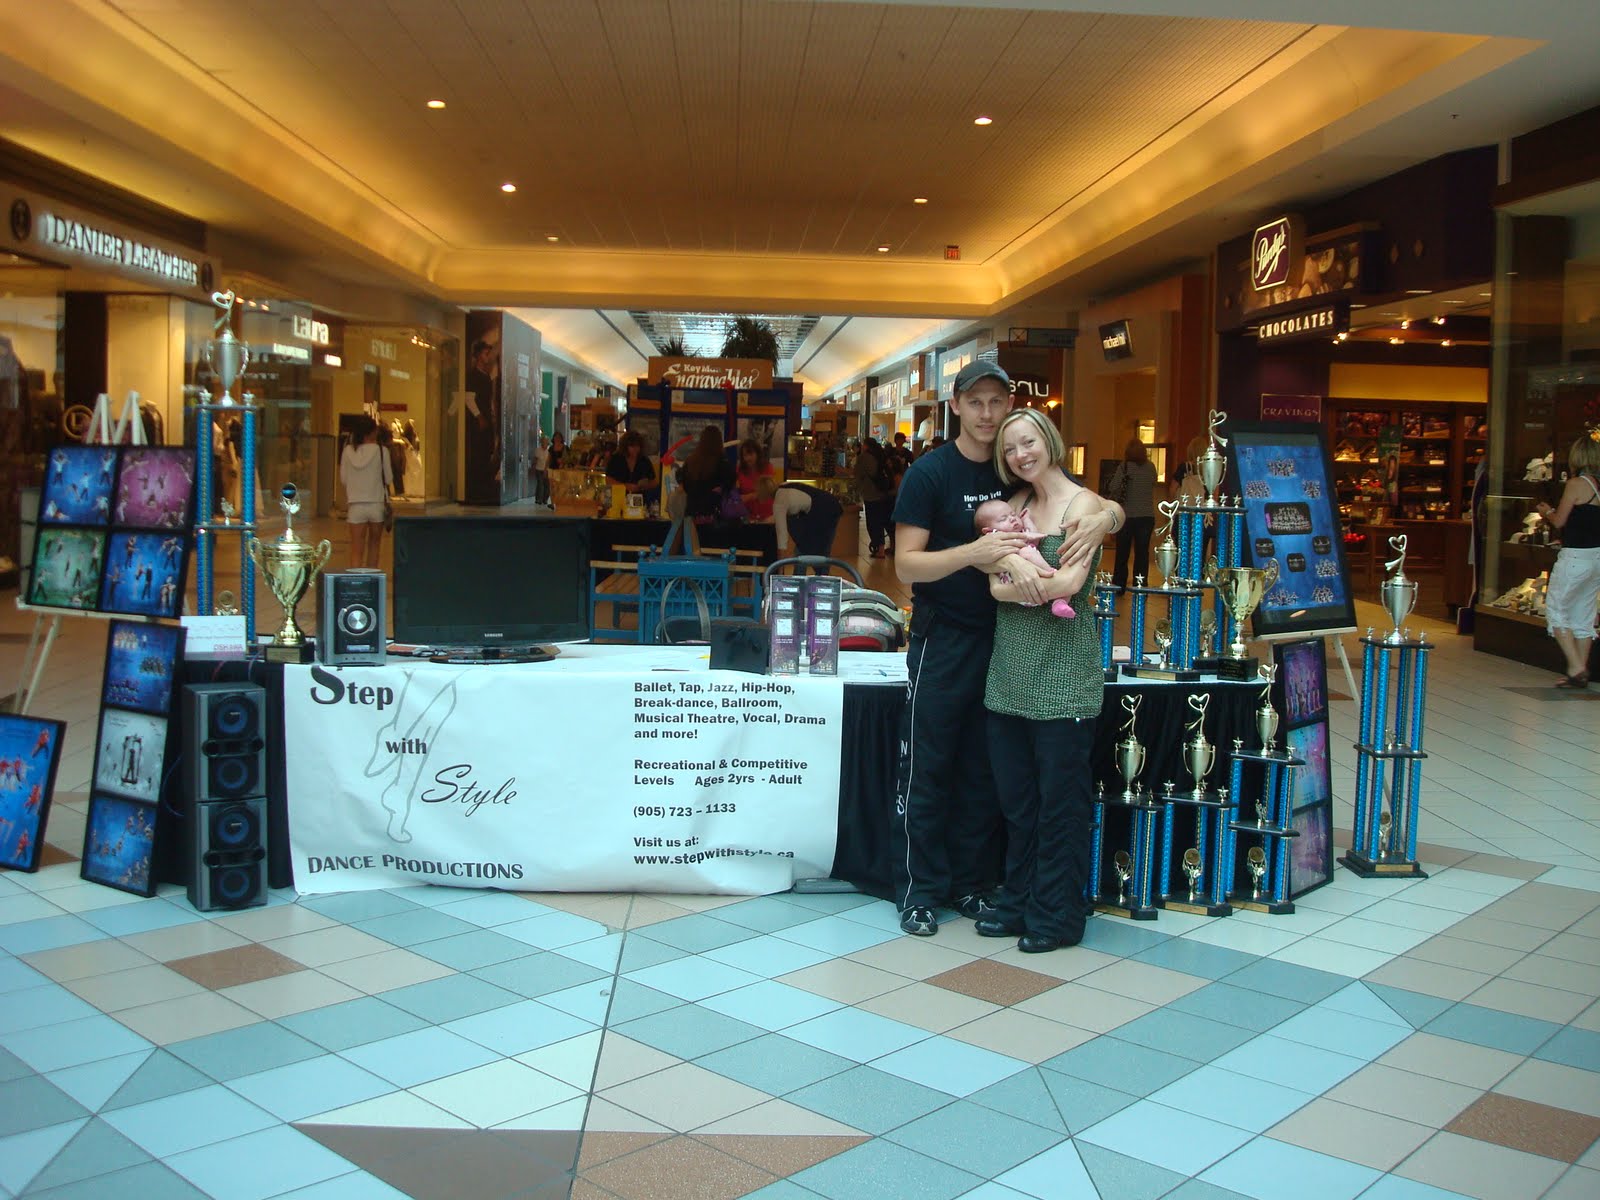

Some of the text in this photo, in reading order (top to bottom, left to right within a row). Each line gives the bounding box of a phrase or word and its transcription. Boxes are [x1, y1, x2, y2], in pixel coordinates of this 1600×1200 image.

[52, 216, 198, 285] DANIER LEATHER
[293, 314, 329, 345] Laura
[1259, 310, 1334, 339] CHOCOLATES
[683, 364, 701, 374] Key
[1263, 407, 1319, 416] CRAVINGS
[310, 665, 394, 711] Step
[634, 682, 795, 695] Ballet, Tap, Jazz, Hip-Hop,
[634, 698, 782, 709] Break-dance, Ballroom,
[634, 713, 826, 725] Musical Theatre, Vocal, Drama
[634, 728, 698, 739] and more!
[386, 738, 428, 755] with
[634, 758, 808, 770] Recreational & Competitive
[634, 775, 675, 786] Levels
[694, 774, 724, 787] Ages
[727, 773, 755, 785] 2yrs
[768, 774, 803, 785] Adult
[421, 764, 517, 817] Style
[633, 806, 666, 818] (905)
[669, 806, 693, 817] 723
[705, 803, 736, 814] 1133
[633, 836, 699, 847] Visit us at:
[307, 854, 524, 879] DANCE PRODUCTIONS
